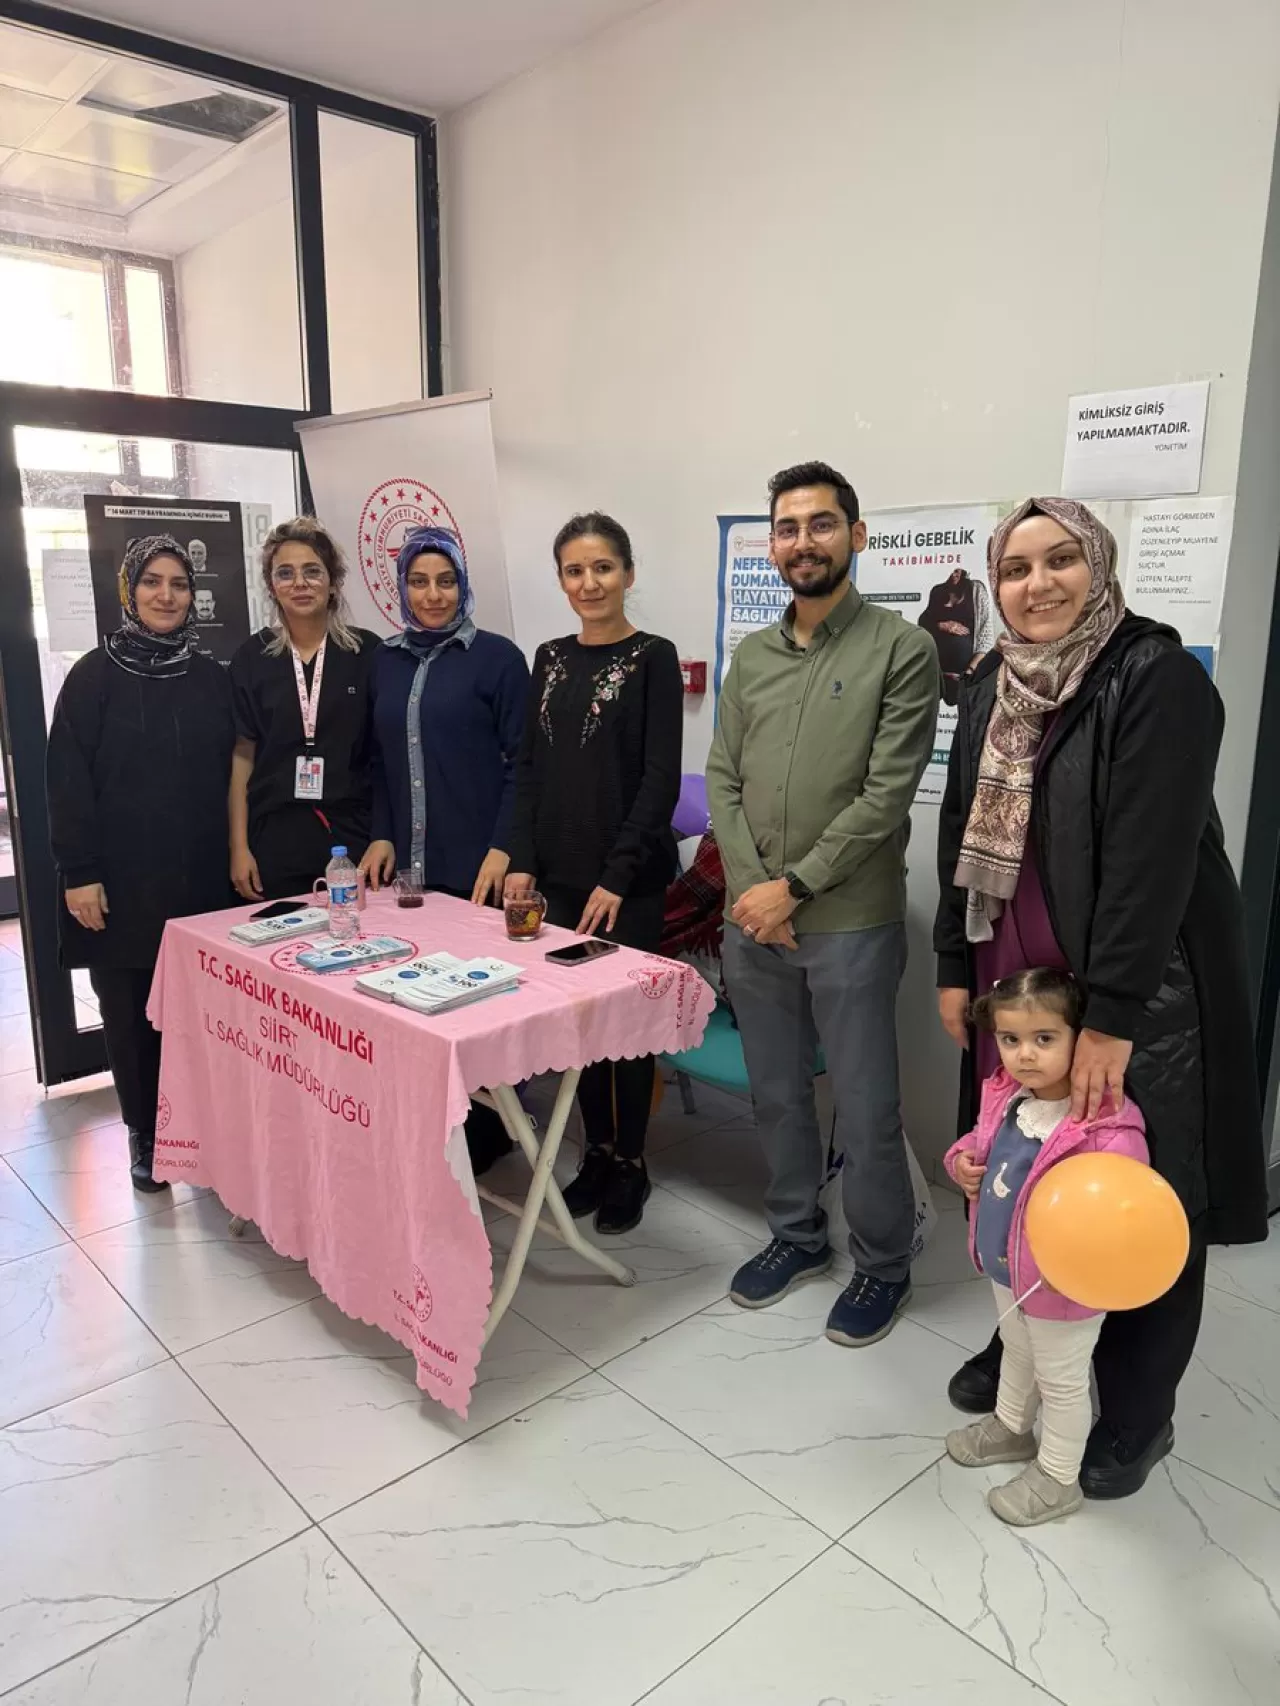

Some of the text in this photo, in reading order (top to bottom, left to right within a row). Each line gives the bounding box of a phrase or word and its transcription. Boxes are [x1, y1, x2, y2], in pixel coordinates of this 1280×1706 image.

[1078, 401, 1164, 421] KİMLİKSİZ GİRİŞ
[1077, 421, 1190, 441] YAPILMAMAKTADIR.
[868, 526, 975, 550] RİSKLİ GEBELİK
[882, 553, 961, 566] TAKİBİMİZDE
[198, 949, 374, 1065] T.C. SAĞLIK BAKANLIĞI
[259, 1015, 299, 1052] SİİRT
[217, 1020, 264, 1067] SAĞLIK
[266, 1050, 372, 1129] MÜDÜRLÜĞÜ
